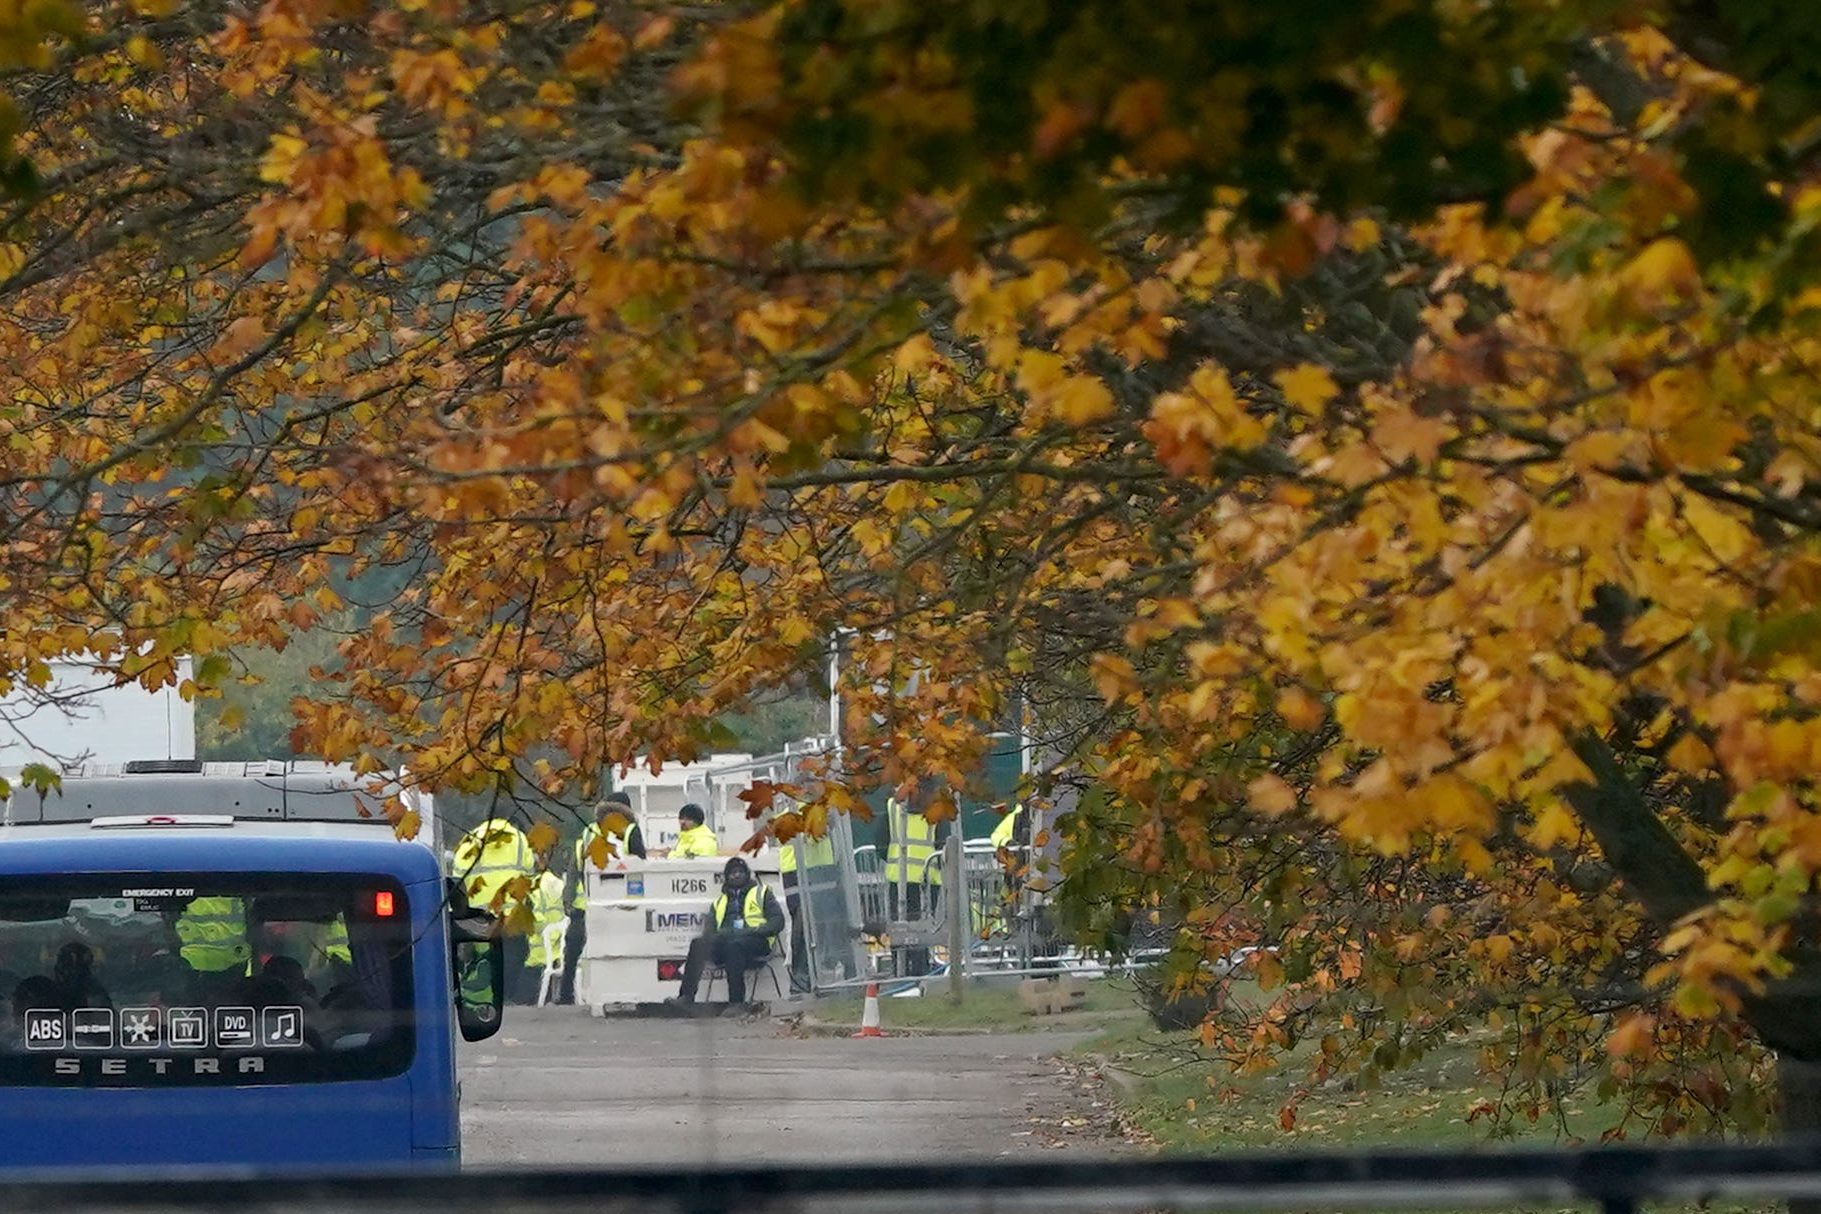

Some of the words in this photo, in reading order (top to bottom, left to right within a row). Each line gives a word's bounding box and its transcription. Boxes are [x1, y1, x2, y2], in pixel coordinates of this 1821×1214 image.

[122, 888, 175, 898] EMERGENCY
[176, 887, 195, 897] EXIT
[671, 879, 707, 894] H266
[30, 1019, 62, 1040] ABS
[181, 1022, 194, 1036] TV
[224, 1015, 246, 1031] DVD
[54, 1056, 265, 1075] SETRA
